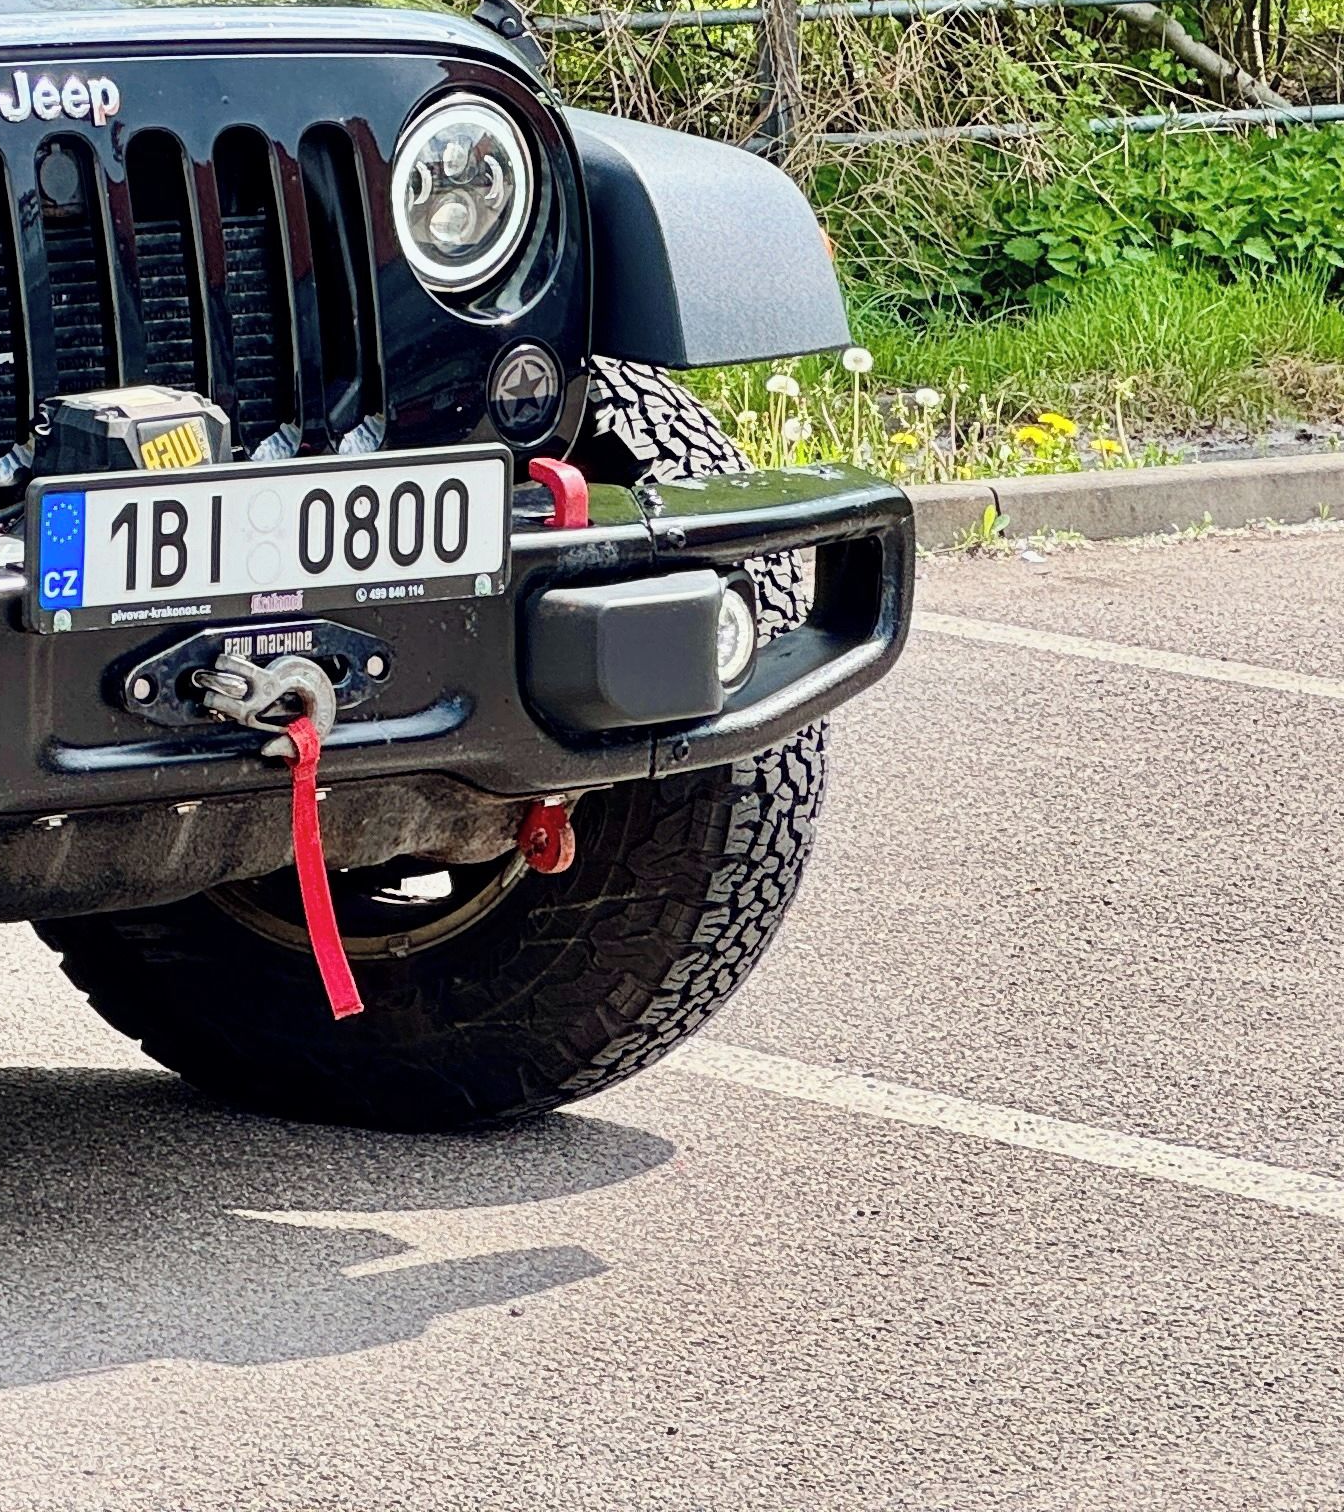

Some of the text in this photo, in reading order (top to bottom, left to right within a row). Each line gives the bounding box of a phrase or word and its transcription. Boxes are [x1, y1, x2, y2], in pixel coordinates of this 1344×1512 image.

[140, 422, 203, 470] RAW
[110, 477, 470, 591] 1BI 0800
[43, 570, 79, 599] CZ
[407, 583, 425, 597] 114
[110, 604, 212, 625] pivovar-krakonos.cz
